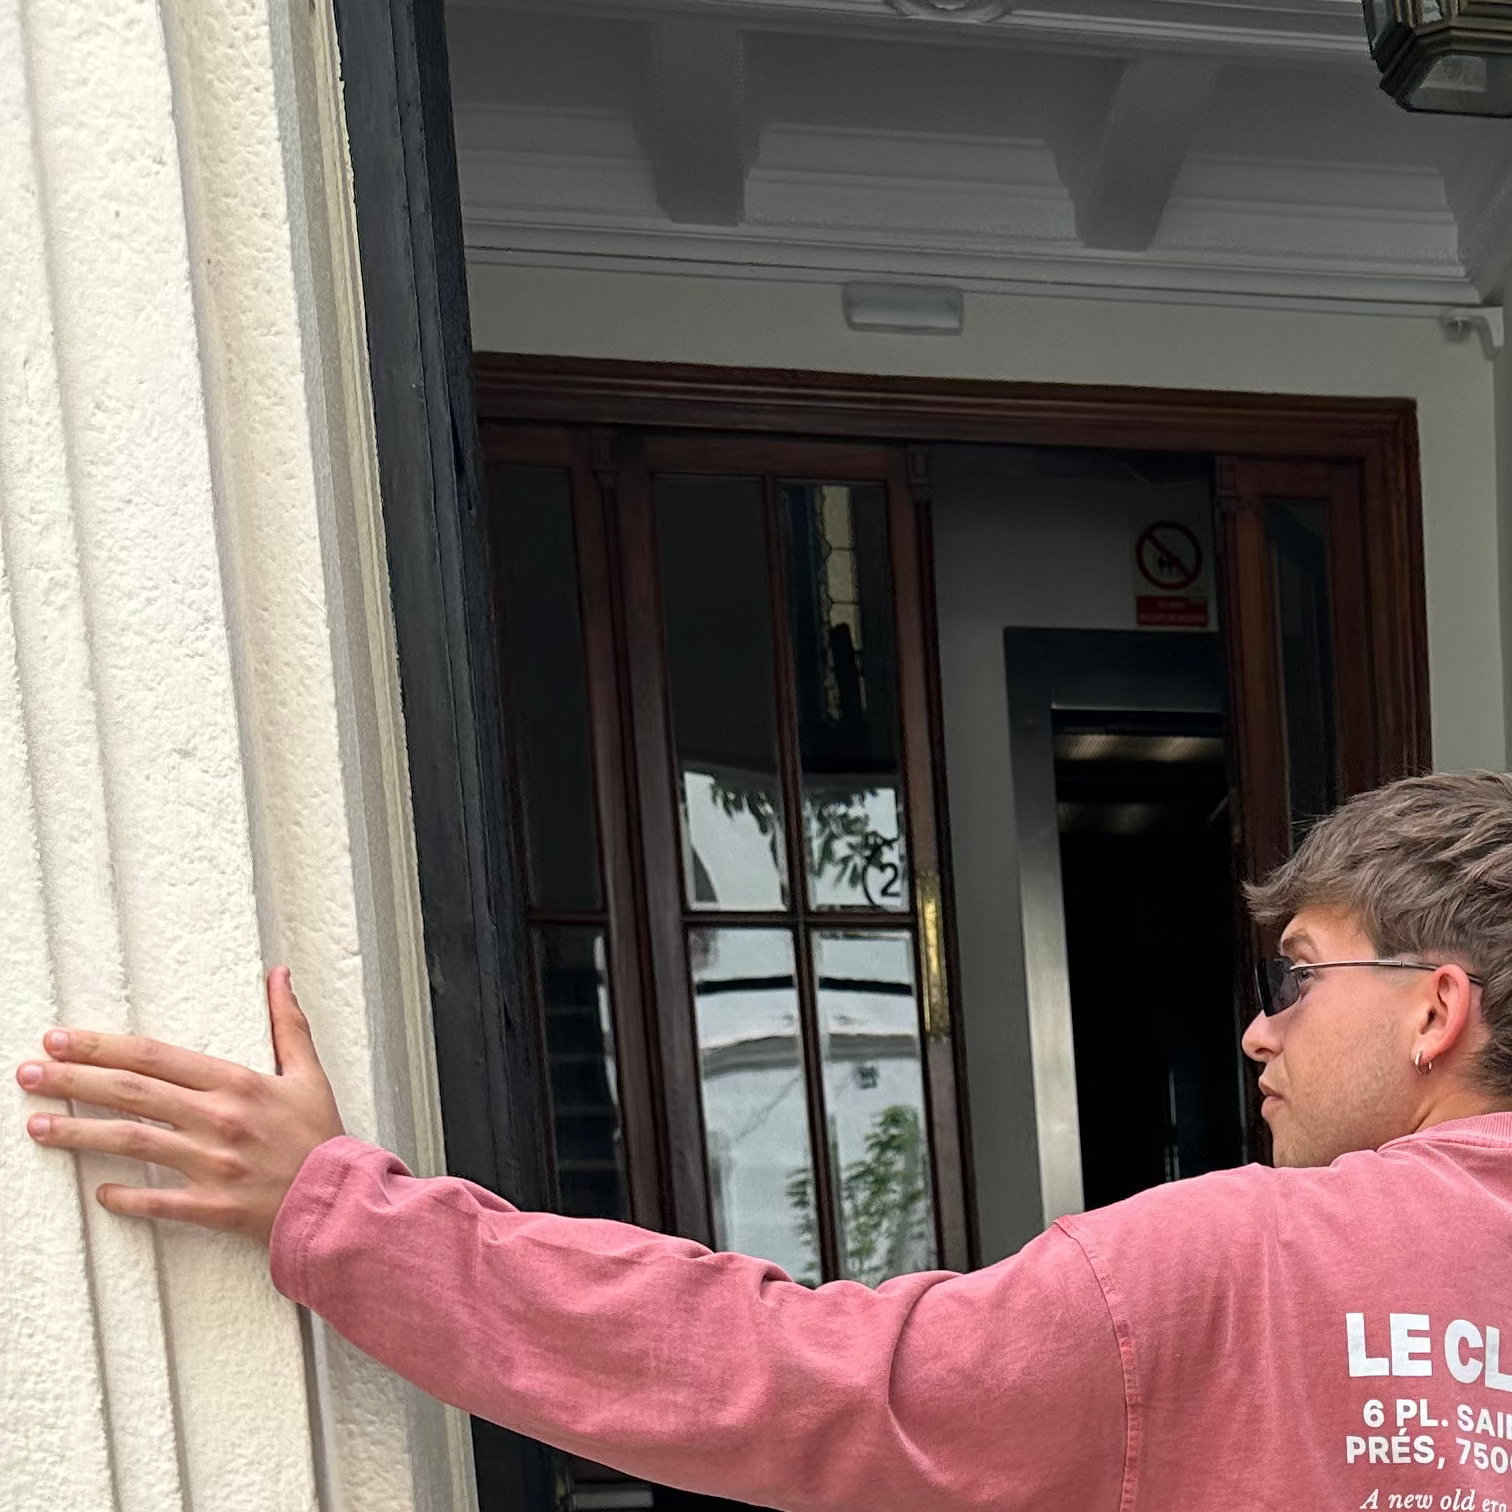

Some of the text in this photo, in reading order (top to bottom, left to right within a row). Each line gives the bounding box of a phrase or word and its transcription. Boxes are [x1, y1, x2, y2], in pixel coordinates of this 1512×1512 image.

[1346, 1313, 1432, 1377] LE
[1363, 1399, 1384, 1427] 6
[1396, 1399, 1449, 1428] PL.
[1346, 1428, 1446, 1469] PRÉS,
[1360, 1489, 1379, 1509] A
[1388, 1494, 1433, 1509] new
[1440, 1489, 1475, 1511] old
